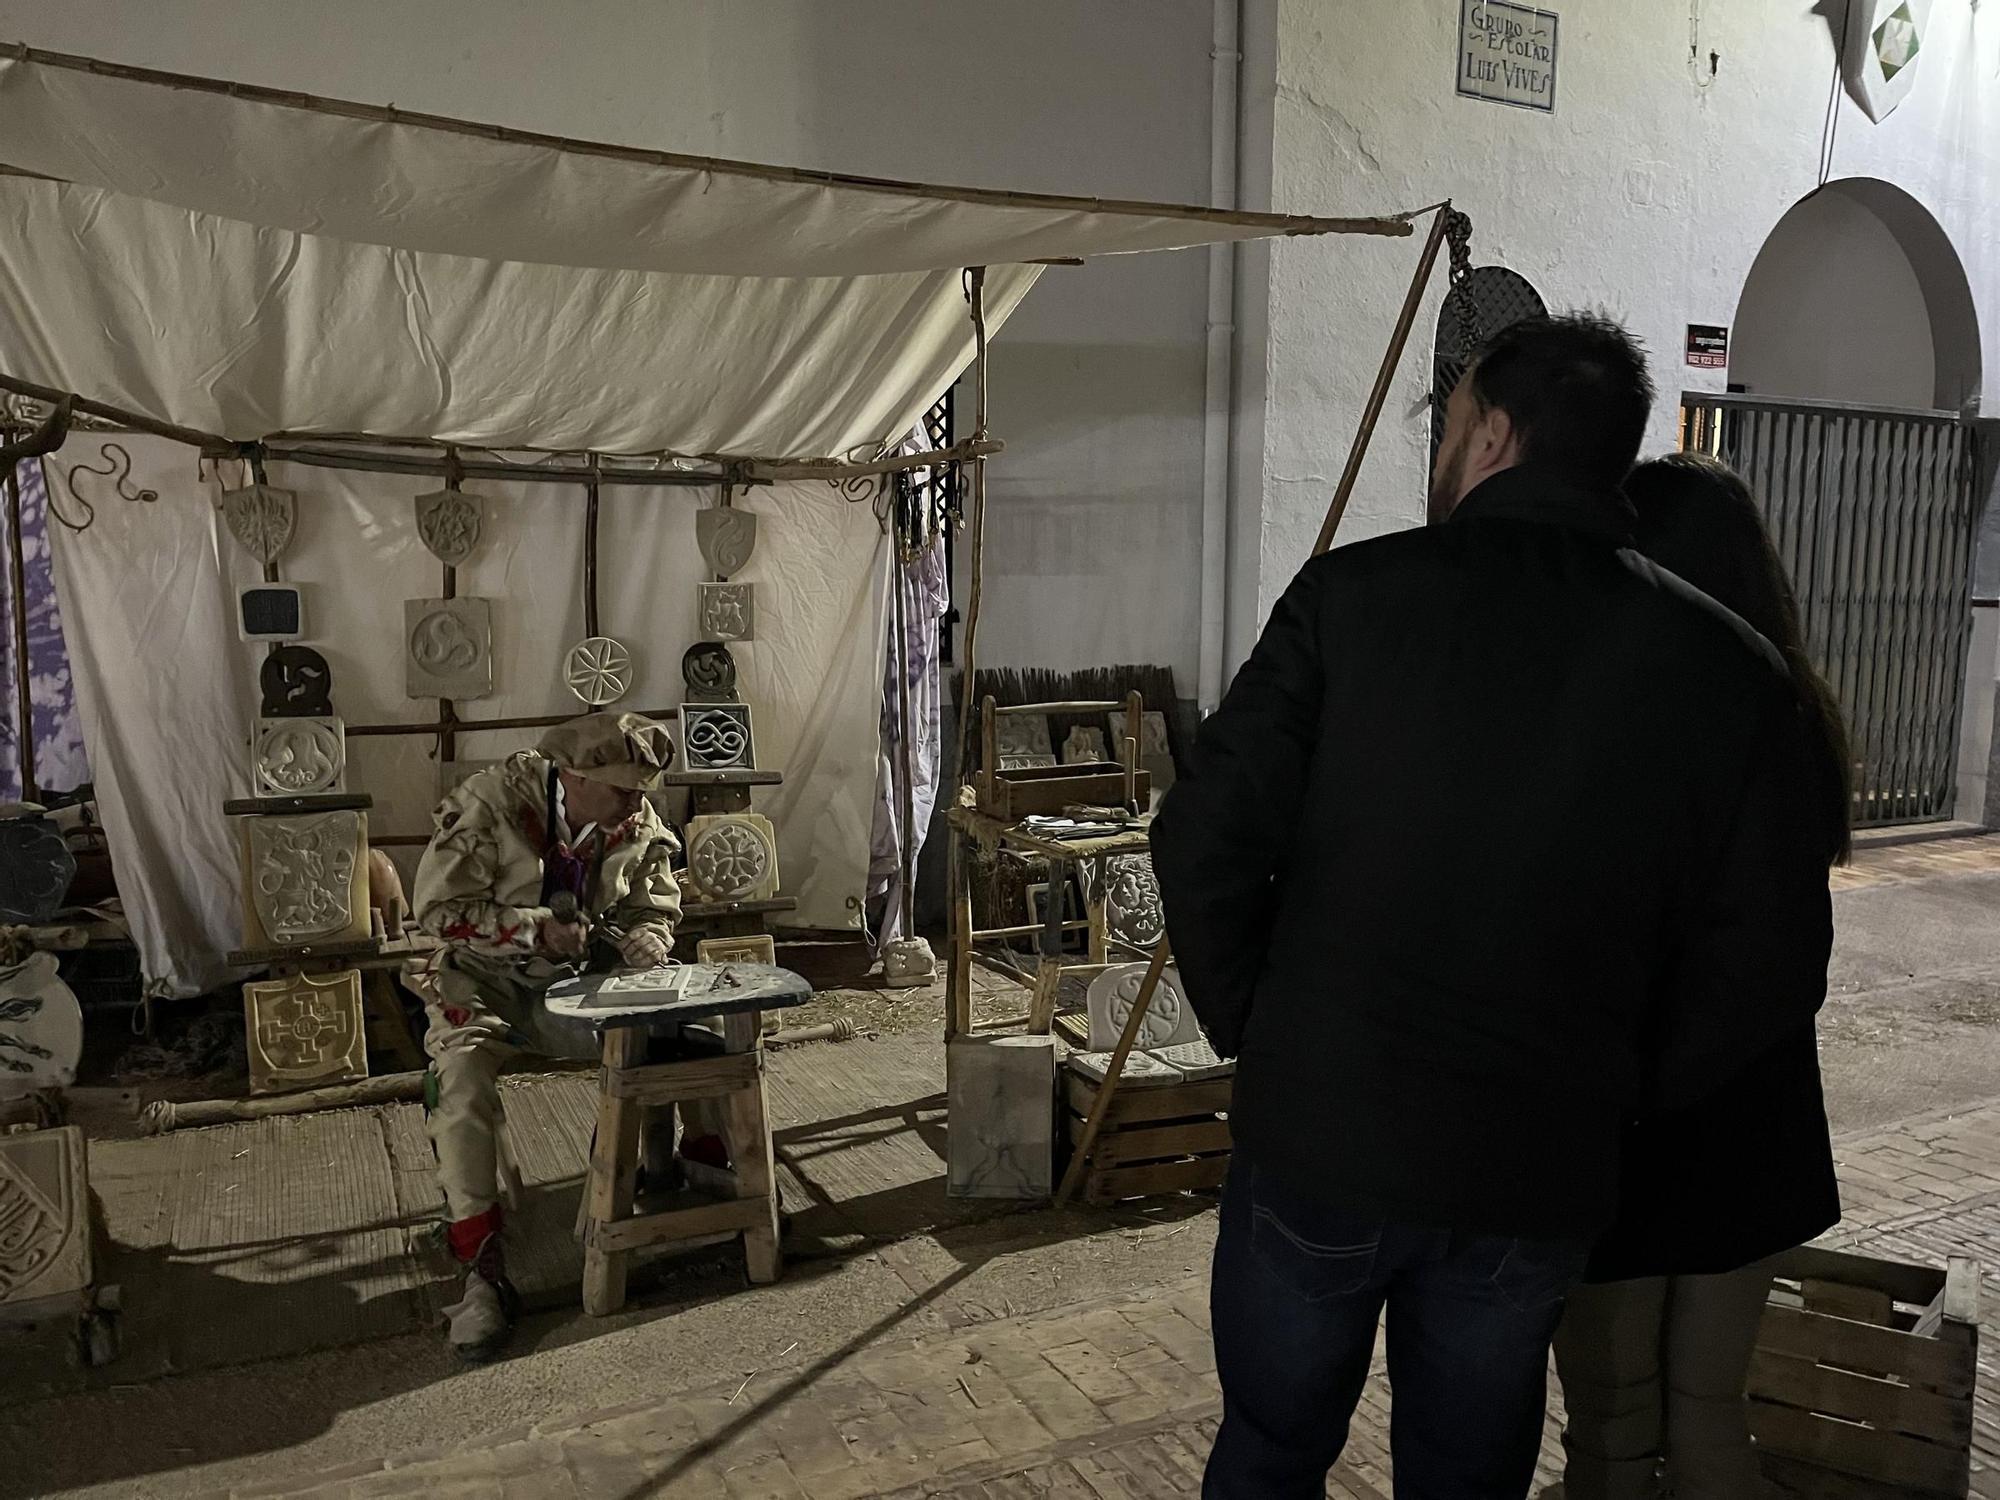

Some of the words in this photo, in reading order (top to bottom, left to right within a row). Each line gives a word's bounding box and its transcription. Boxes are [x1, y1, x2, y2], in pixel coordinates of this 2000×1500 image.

[1471, 6, 1522, 37] GRUPO
[1488, 32, 1550, 62] ESCOLAR
[1466, 52, 1499, 82] LUIS
[1502, 59, 1551, 93] VIVES
